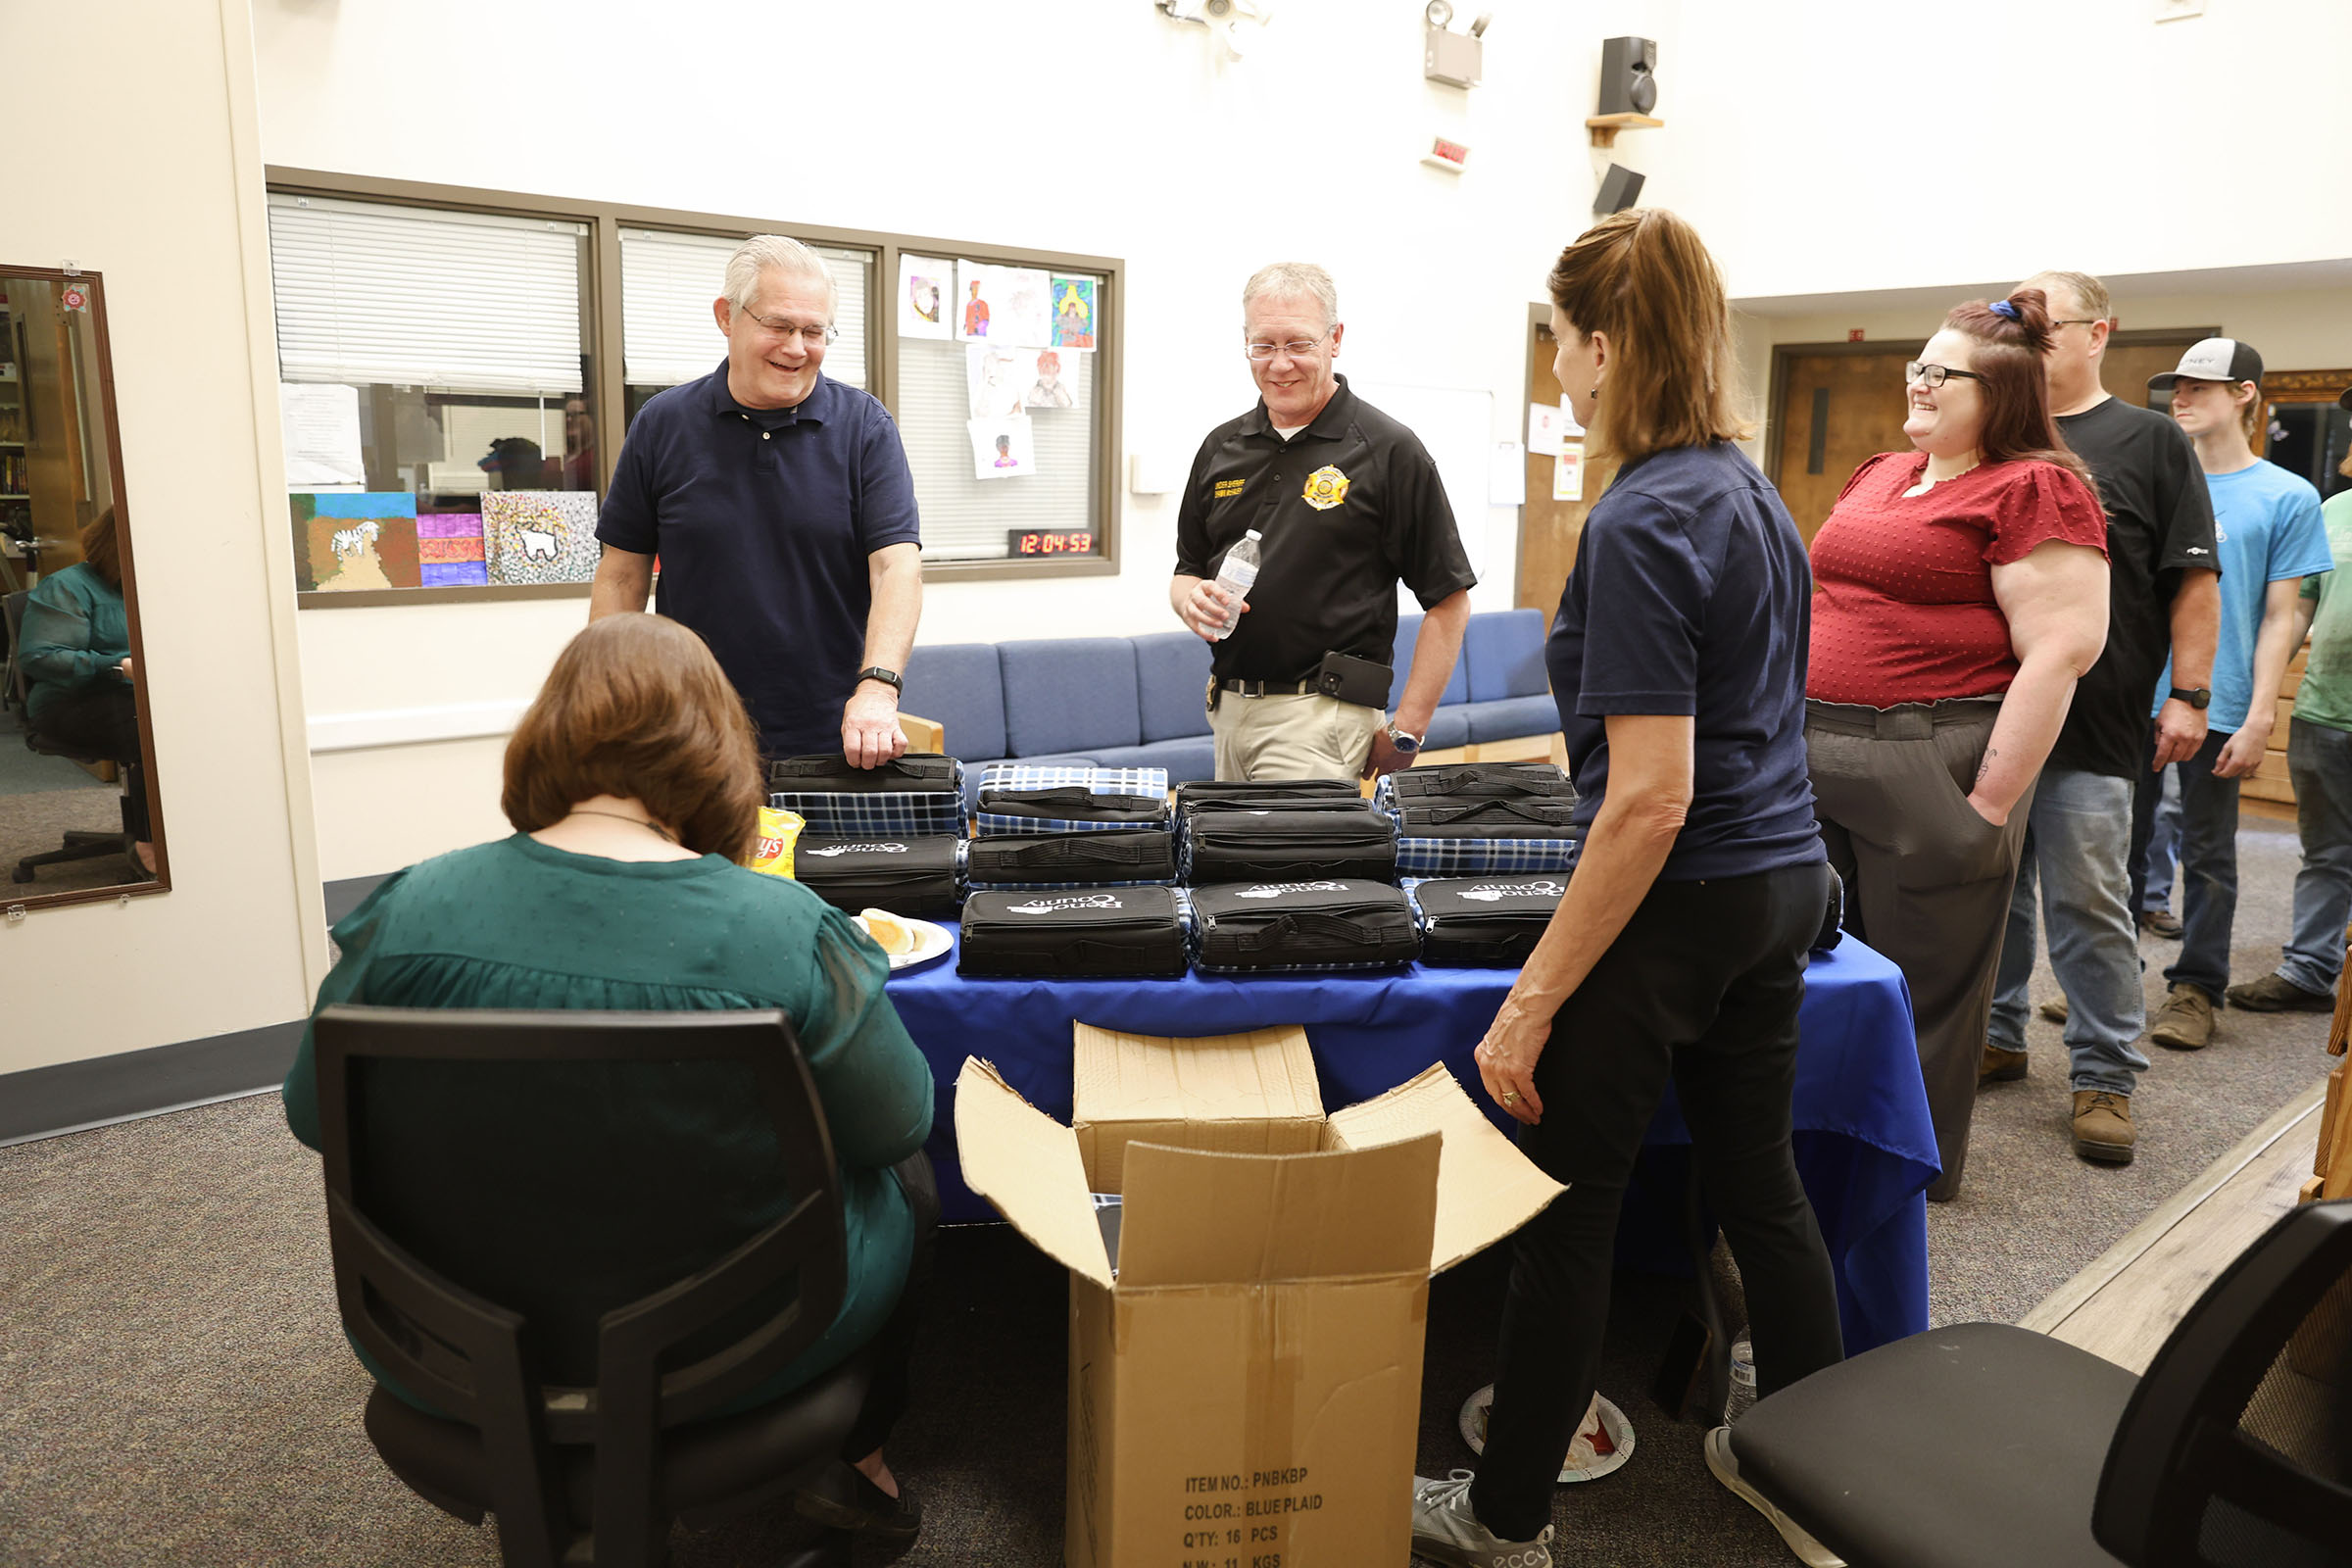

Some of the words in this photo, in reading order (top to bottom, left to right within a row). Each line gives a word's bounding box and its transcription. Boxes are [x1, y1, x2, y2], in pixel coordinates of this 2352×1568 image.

[1020, 533, 1092, 554] 12:04:53
[1248, 880, 1337, 892] County
[1280, 884, 1349, 893] Reno
[1469, 880, 1557, 892] County
[1022, 894, 1115, 906] County
[1053, 901, 1123, 910] Reno
[1185, 1476, 1218, 1493] ITEM
[1252, 1467, 1308, 1488] PNBKBP
[1246, 1498, 1281, 1517] BLUE
[1283, 1494, 1323, 1513] PLAID
[1183, 1531, 1219, 1548] Q'TY:
[1226, 1529, 1241, 1544] 16
[1250, 1525, 1278, 1543] PCS
[1224, 1557, 1239, 1568] 11
[1252, 1553, 1281, 1568] KGS
